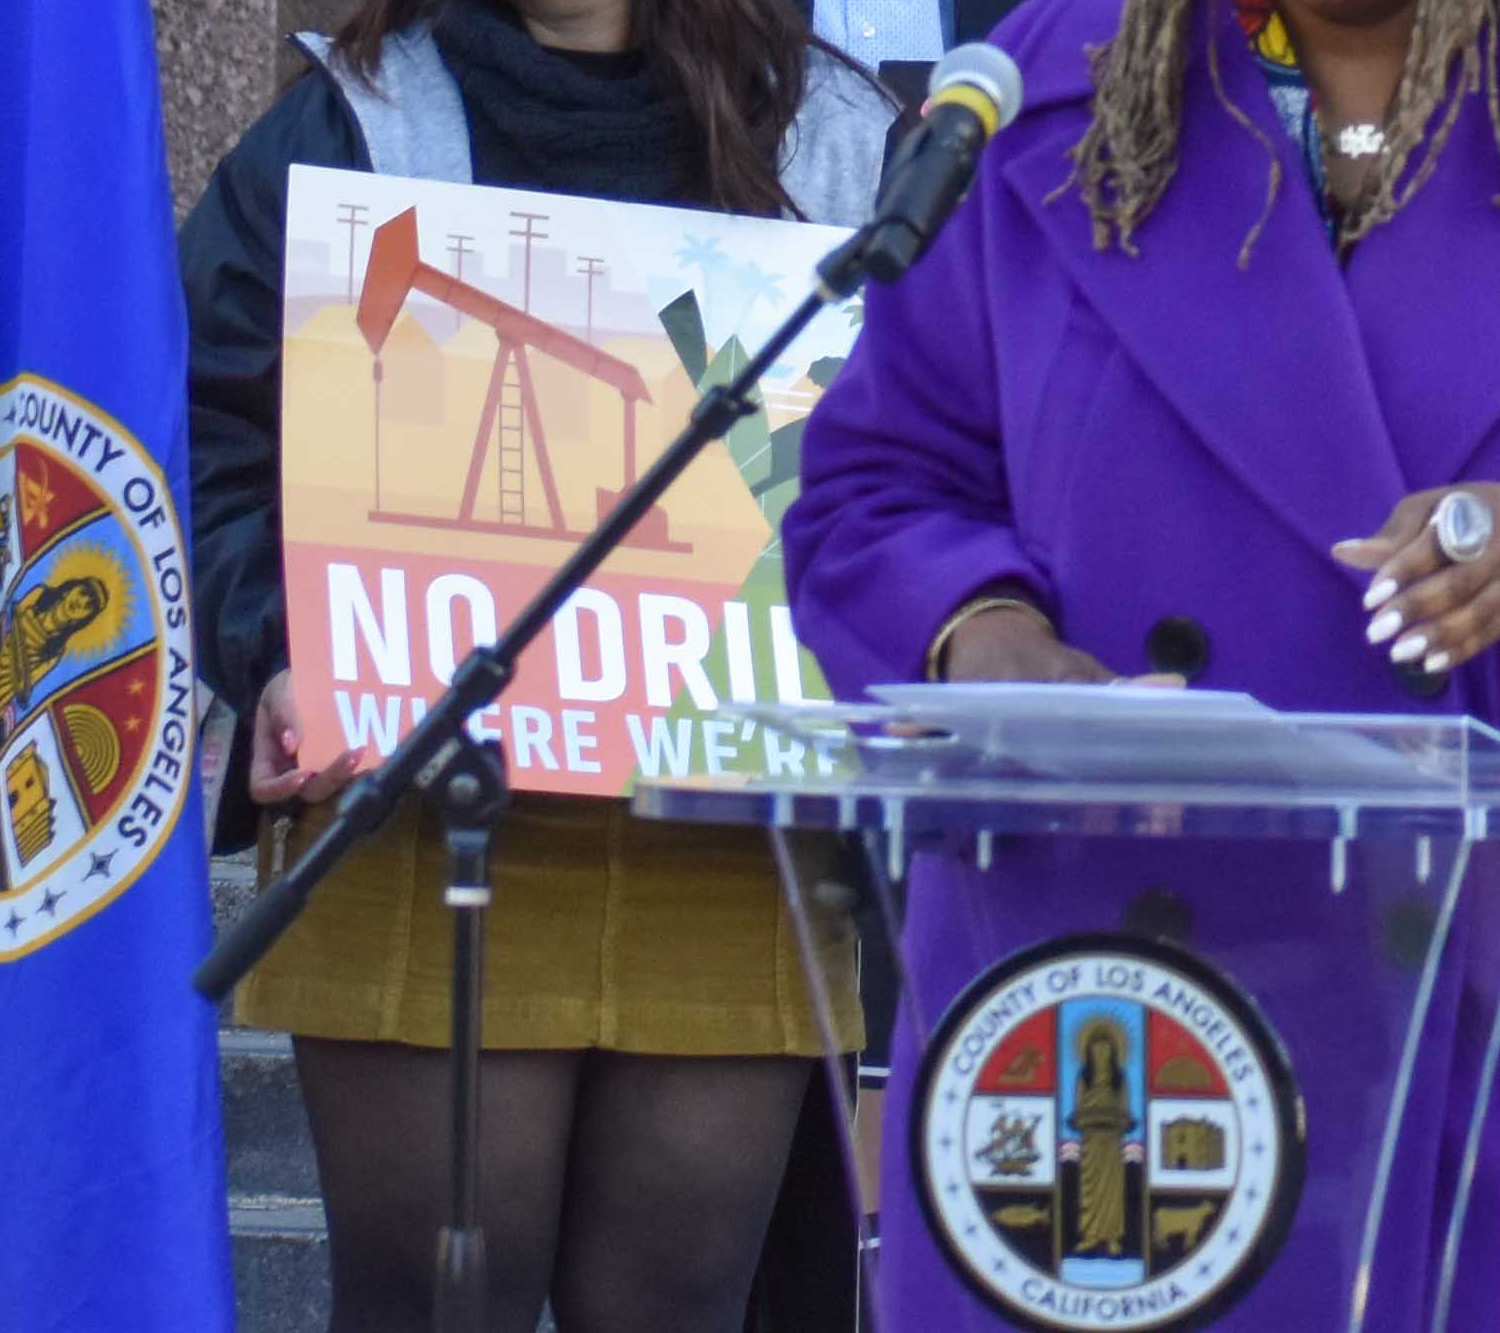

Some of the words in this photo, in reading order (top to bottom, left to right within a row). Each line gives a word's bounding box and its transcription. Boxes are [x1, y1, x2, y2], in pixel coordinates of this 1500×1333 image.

[20, 392, 125, 473] OUNTY
[123, 476, 165, 530] OF
[152, 545, 188, 631] LOS
[327, 563, 498, 689] NO
[118, 646, 193, 850] ANGELES
[333, 689, 603, 774] WERE
[953, 980, 1037, 1077] COUNTY
[1046, 965, 1084, 994] OF
[1096, 965, 1145, 994] LOS
[1155, 981, 1254, 1084] ANGELES
[1020, 1276, 1188, 1322] CALIFORNIA
